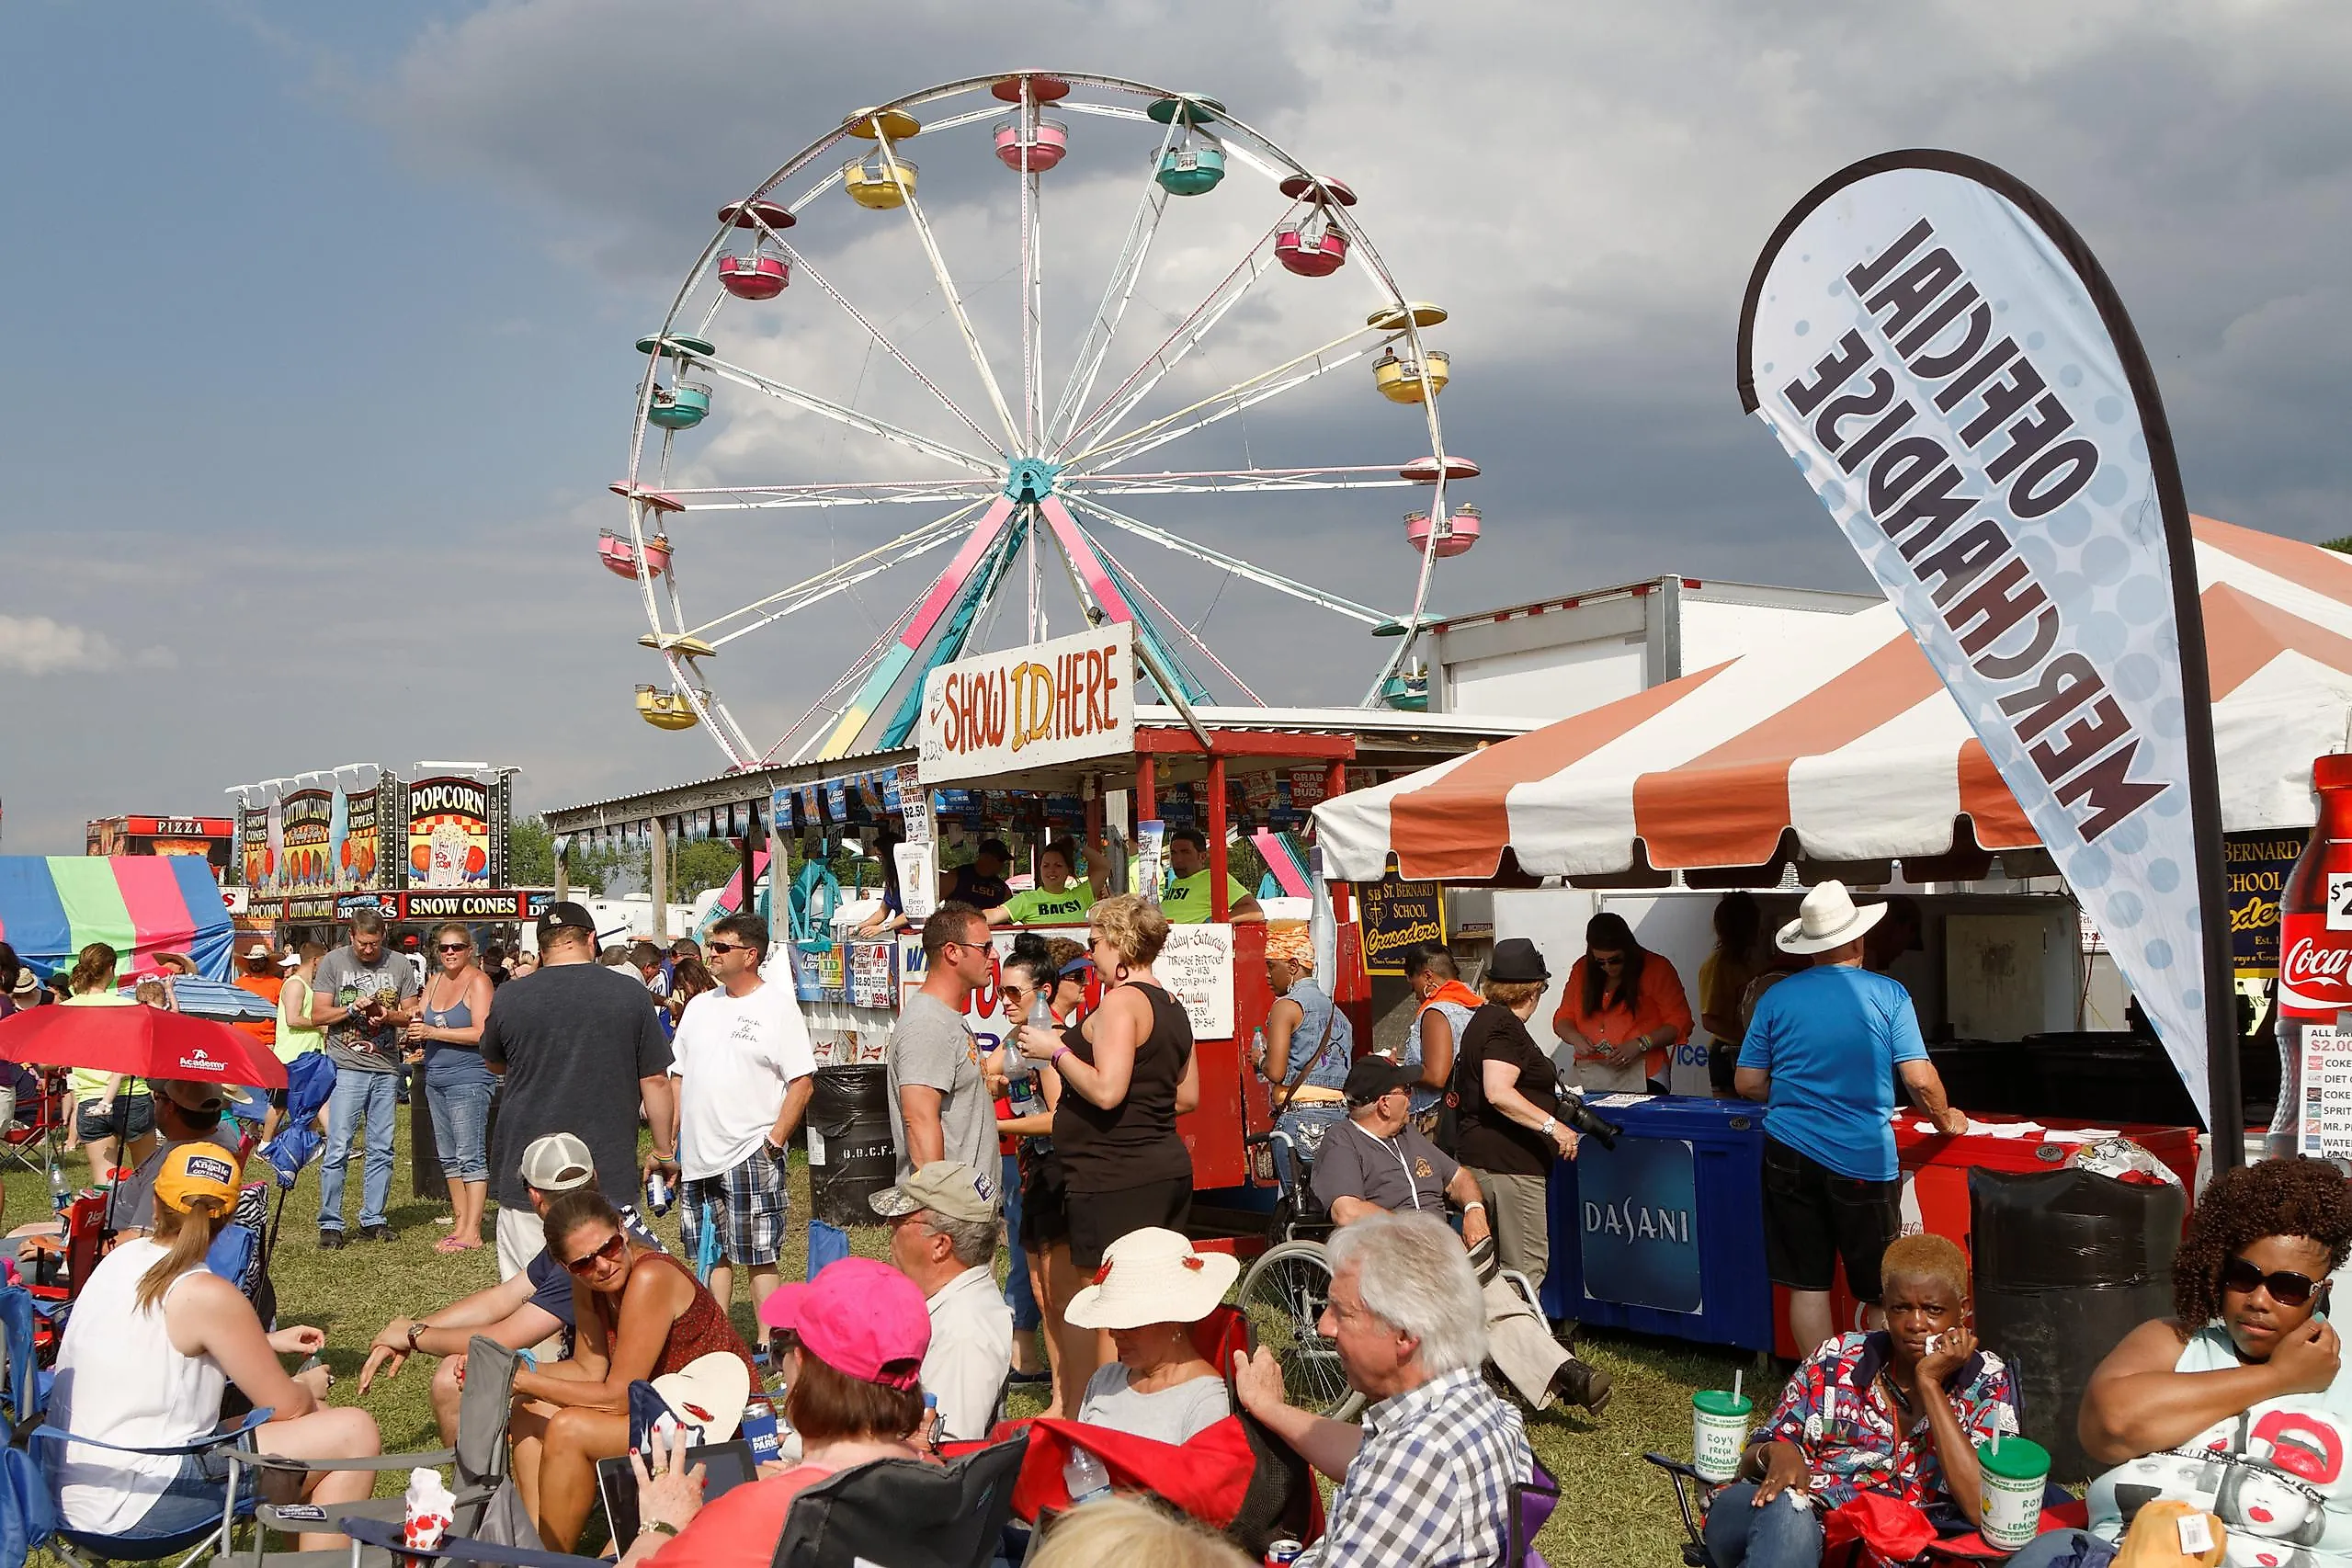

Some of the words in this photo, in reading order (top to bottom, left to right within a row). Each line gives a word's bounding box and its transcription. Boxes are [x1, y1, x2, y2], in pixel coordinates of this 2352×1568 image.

[944, 665, 1006, 755] SHOW
[1010, 661, 1055, 753] I.D.
[1055, 644, 1119, 740] HERE
[1293, 773, 1324, 782] GRAB
[411, 785, 485, 816] POPCORN
[1293, 788, 1324, 798] BUDS
[349, 797, 375, 812] CANDY
[904, 805, 926, 819] $2.50
[282, 798, 309, 827] COTTON
[309, 798, 331, 820] CANDY
[349, 812, 375, 828] APPLES
[245, 814, 267, 827] SNOW
[157, 823, 204, 834] PIZZA
[245, 830, 267, 842] CONES
[490, 797, 498, 874] SWEETS
[2224, 840, 2301, 862] BERNARD
[2228, 872, 2284, 892] CHOOL
[971, 885, 994, 897] LSU
[1368, 889, 1381, 901] SB
[1396, 883, 1434, 898] BERNARD
[247, 903, 284, 919] OPCORN
[290, 901, 312, 918] COTTON
[314, 900, 335, 917] CANDY
[410, 897, 459, 915] SNOW
[462, 897, 517, 914] CONES
[1393, 903, 1428, 919] SCHOOL
[1366, 921, 1441, 956] Crusaders
[871, 993, 888, 1005] 1994
[1176, 988, 1210, 1008] Sunday
[2311, 1029, 2331, 1038] ALL
[179, 1057, 225, 1071] Academy
[2324, 1091, 2351, 1099] COKE
[191, 1159, 229, 1176] Angelle
[1585, 1197, 1688, 1244] DASANI
[1707, 1434, 1734, 1446] ROY'S
[1710, 1447, 1732, 1456] FRESH
